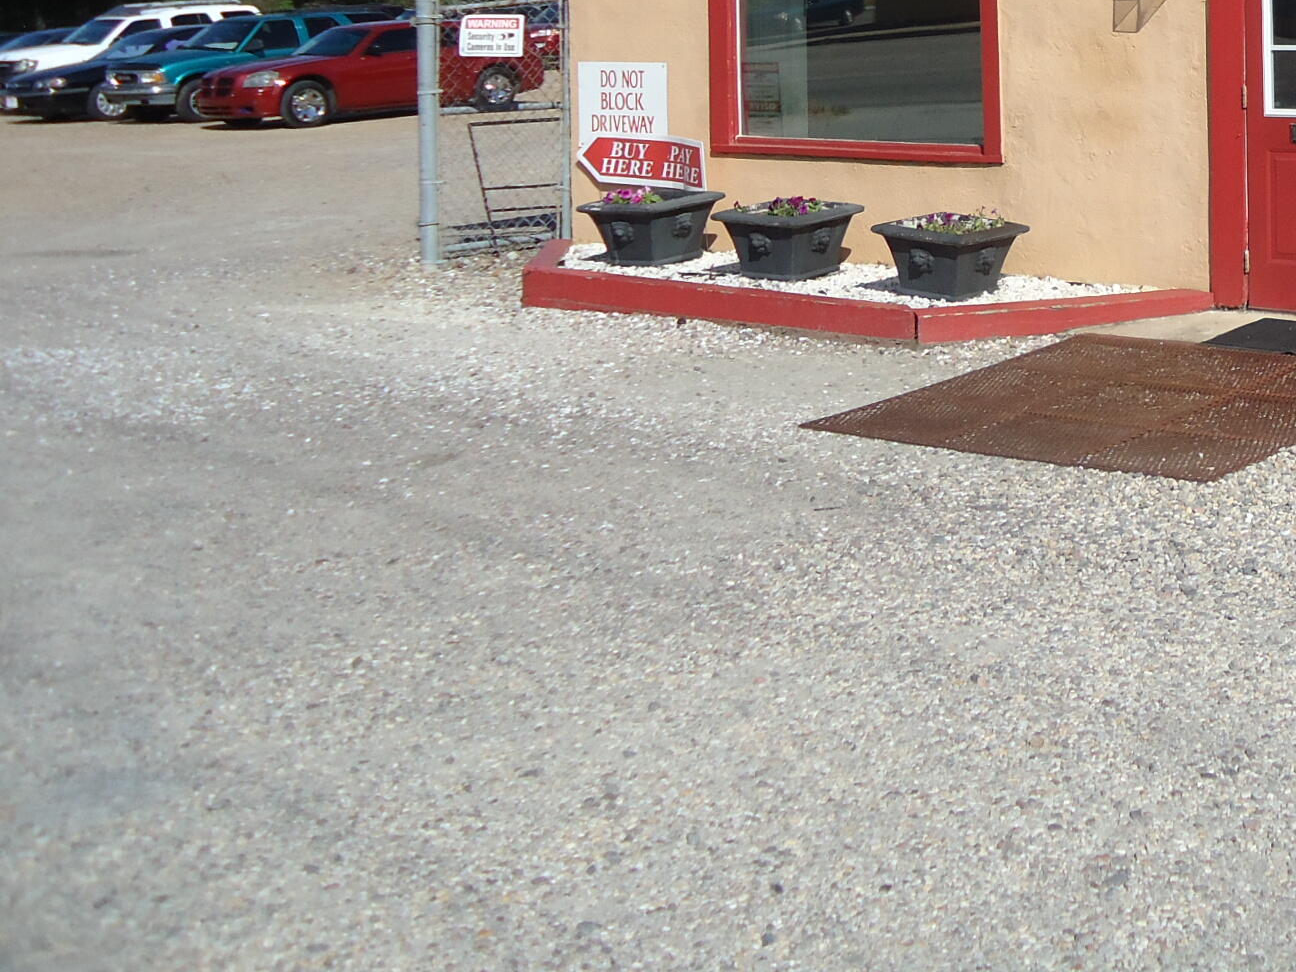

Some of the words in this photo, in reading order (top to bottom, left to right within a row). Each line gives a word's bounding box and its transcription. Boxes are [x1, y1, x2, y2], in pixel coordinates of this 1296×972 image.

[467, 19, 518, 29] WARNING
[600, 69, 617, 89] DO
[621, 70, 645, 89] NOT
[600, 91, 645, 111] BLOCK
[591, 114, 655, 134] DRIVEWAY
[609, 141, 650, 160] BUY
[669, 145, 694, 165] PAY
[600, 157, 655, 177] HERE
[661, 161, 700, 184] HERE
